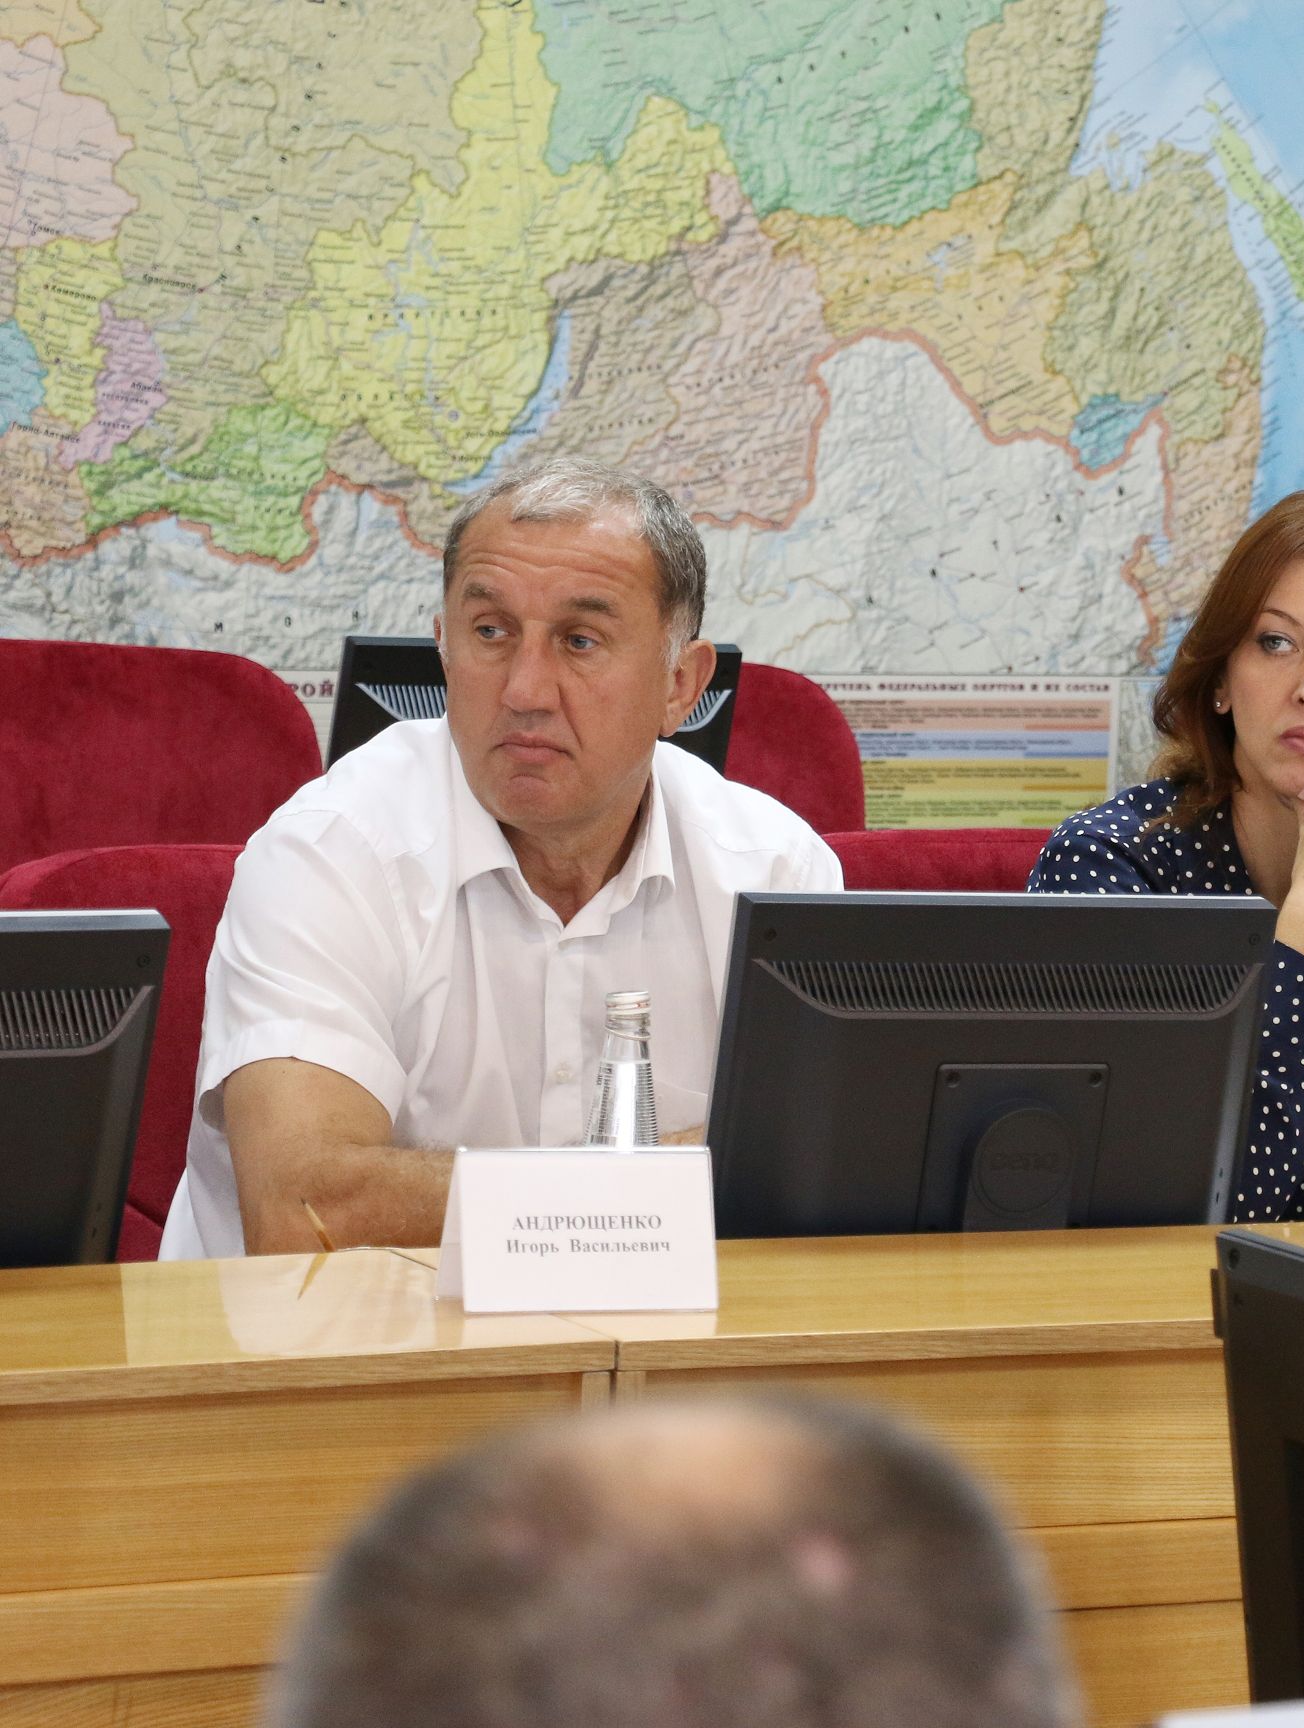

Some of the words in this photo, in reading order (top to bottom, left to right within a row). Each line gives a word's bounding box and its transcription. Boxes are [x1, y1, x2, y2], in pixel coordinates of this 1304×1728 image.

[512, 1215, 662, 1232] АНДРЮЩЕНКО
[506, 1239, 559, 1256] Игорь
[570, 1238, 671, 1254] Васильевич
